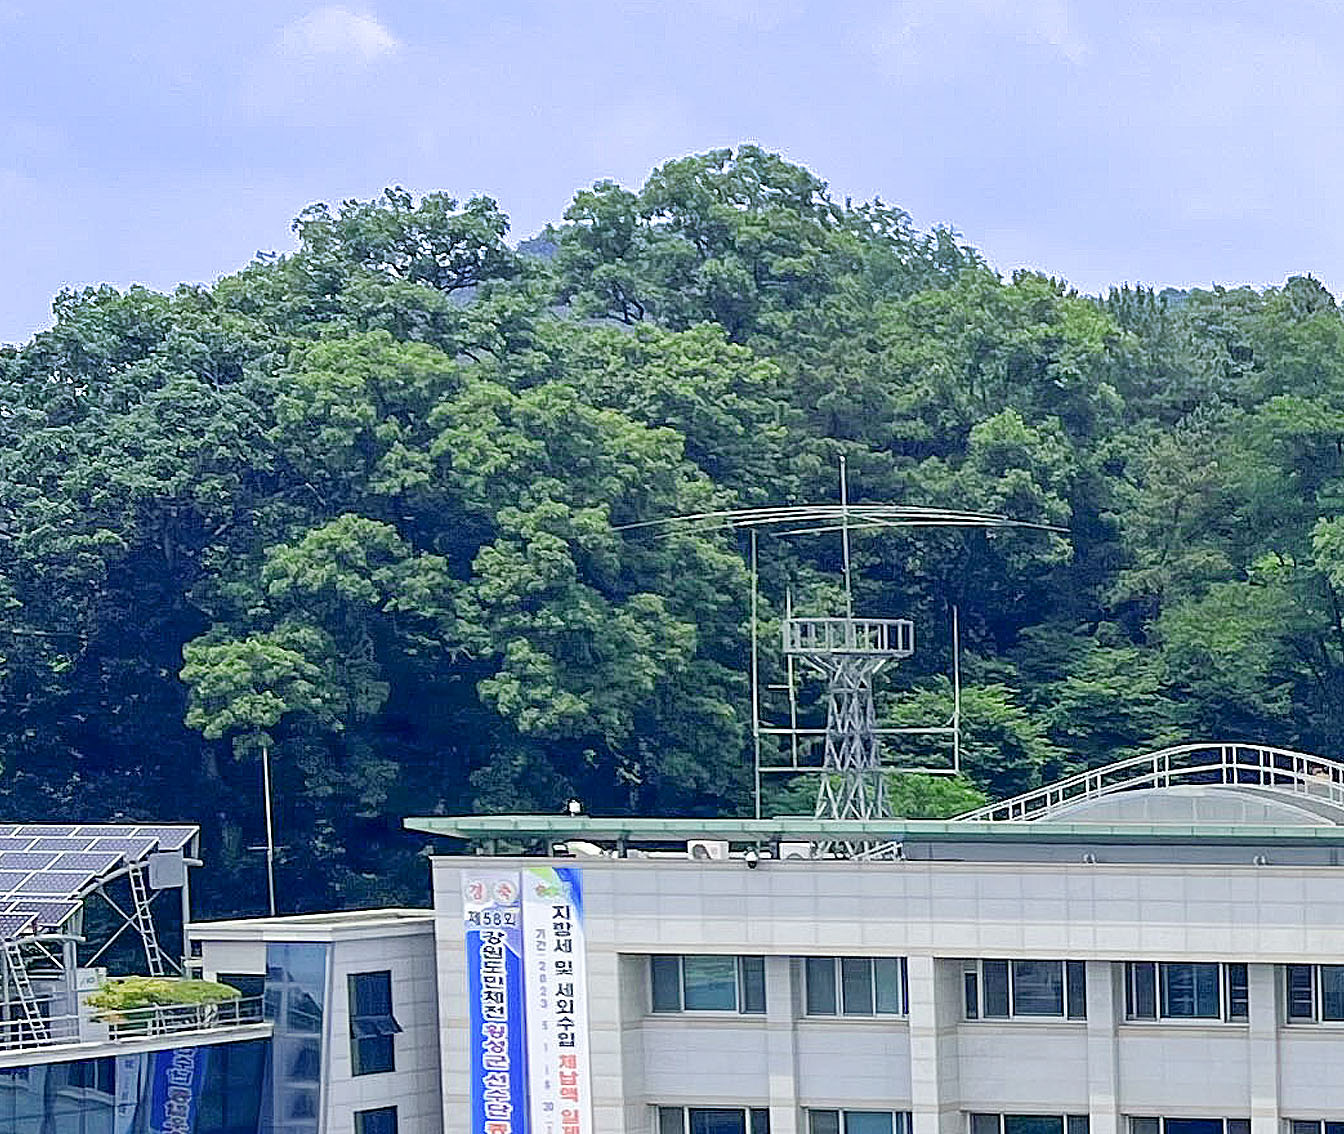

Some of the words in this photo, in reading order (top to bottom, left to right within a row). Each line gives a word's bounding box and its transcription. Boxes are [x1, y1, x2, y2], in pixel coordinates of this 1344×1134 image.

[467, 911, 516, 927] 제58회
[551, 905, 573, 953] 지방세
[554, 961, 574, 975] 및
[555, 983, 576, 1048] 세외수입
[559, 1054, 580, 1101] 체납액
